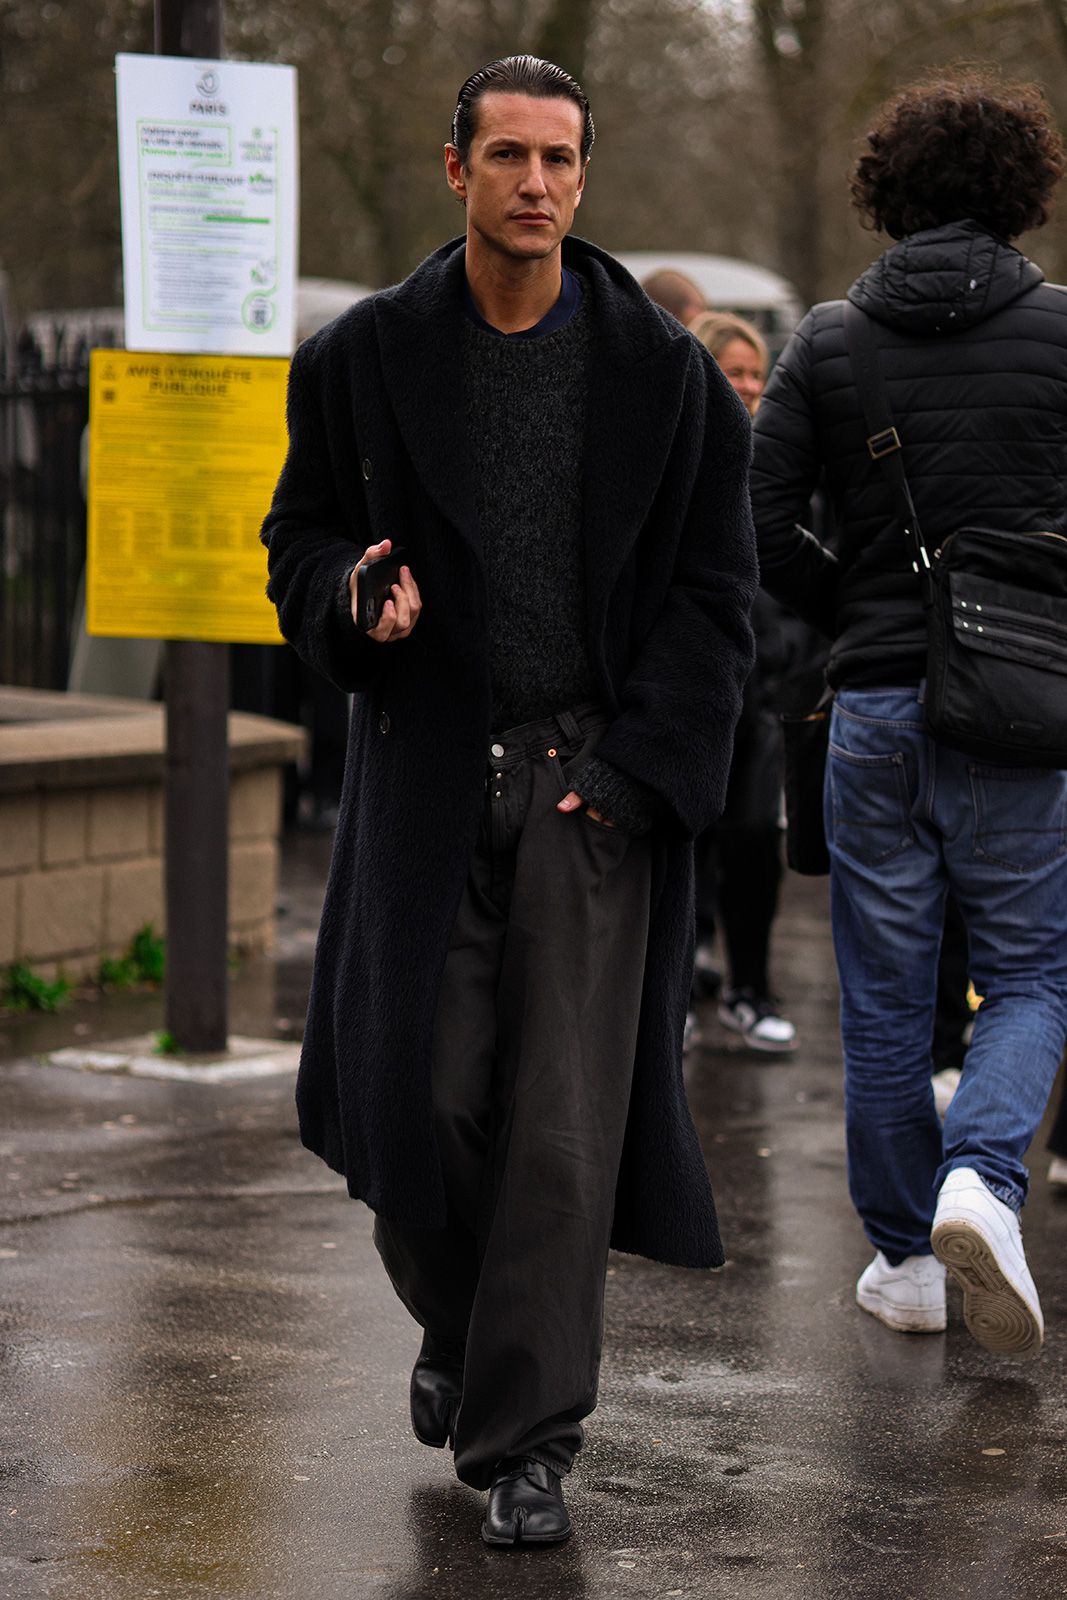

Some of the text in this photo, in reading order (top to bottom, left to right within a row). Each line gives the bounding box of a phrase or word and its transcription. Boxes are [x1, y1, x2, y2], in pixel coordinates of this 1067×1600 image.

[189, 101, 227, 116] PARIS
[127, 364, 161, 378] AVIS
[149, 382, 228, 397] PUBLIQUE
